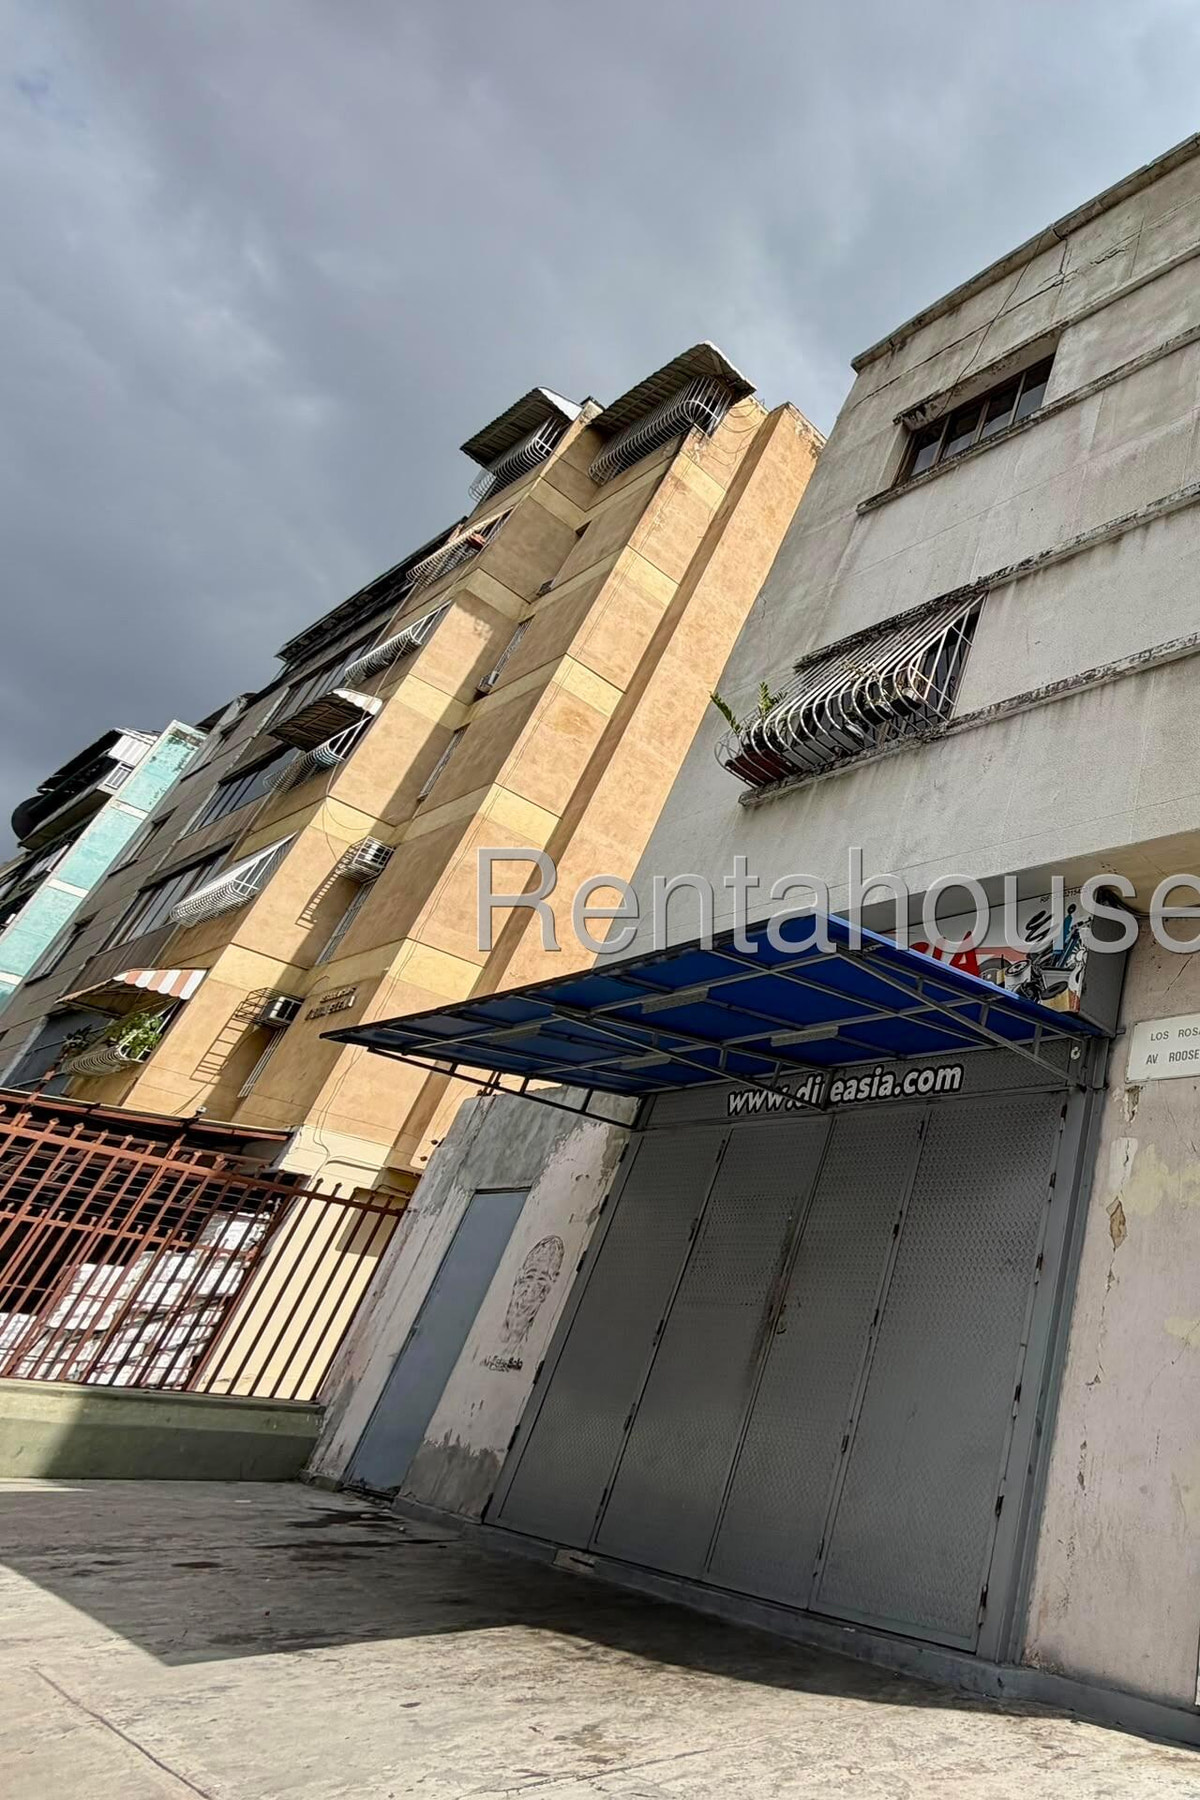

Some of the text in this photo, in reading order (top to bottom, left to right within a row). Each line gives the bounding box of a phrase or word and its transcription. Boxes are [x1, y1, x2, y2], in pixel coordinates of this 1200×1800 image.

[1150, 1030, 1169, 1042] LOS
[1145, 1053, 1159, 1065] AV
[729, 1065, 963, 1114] www.dieasia.com
